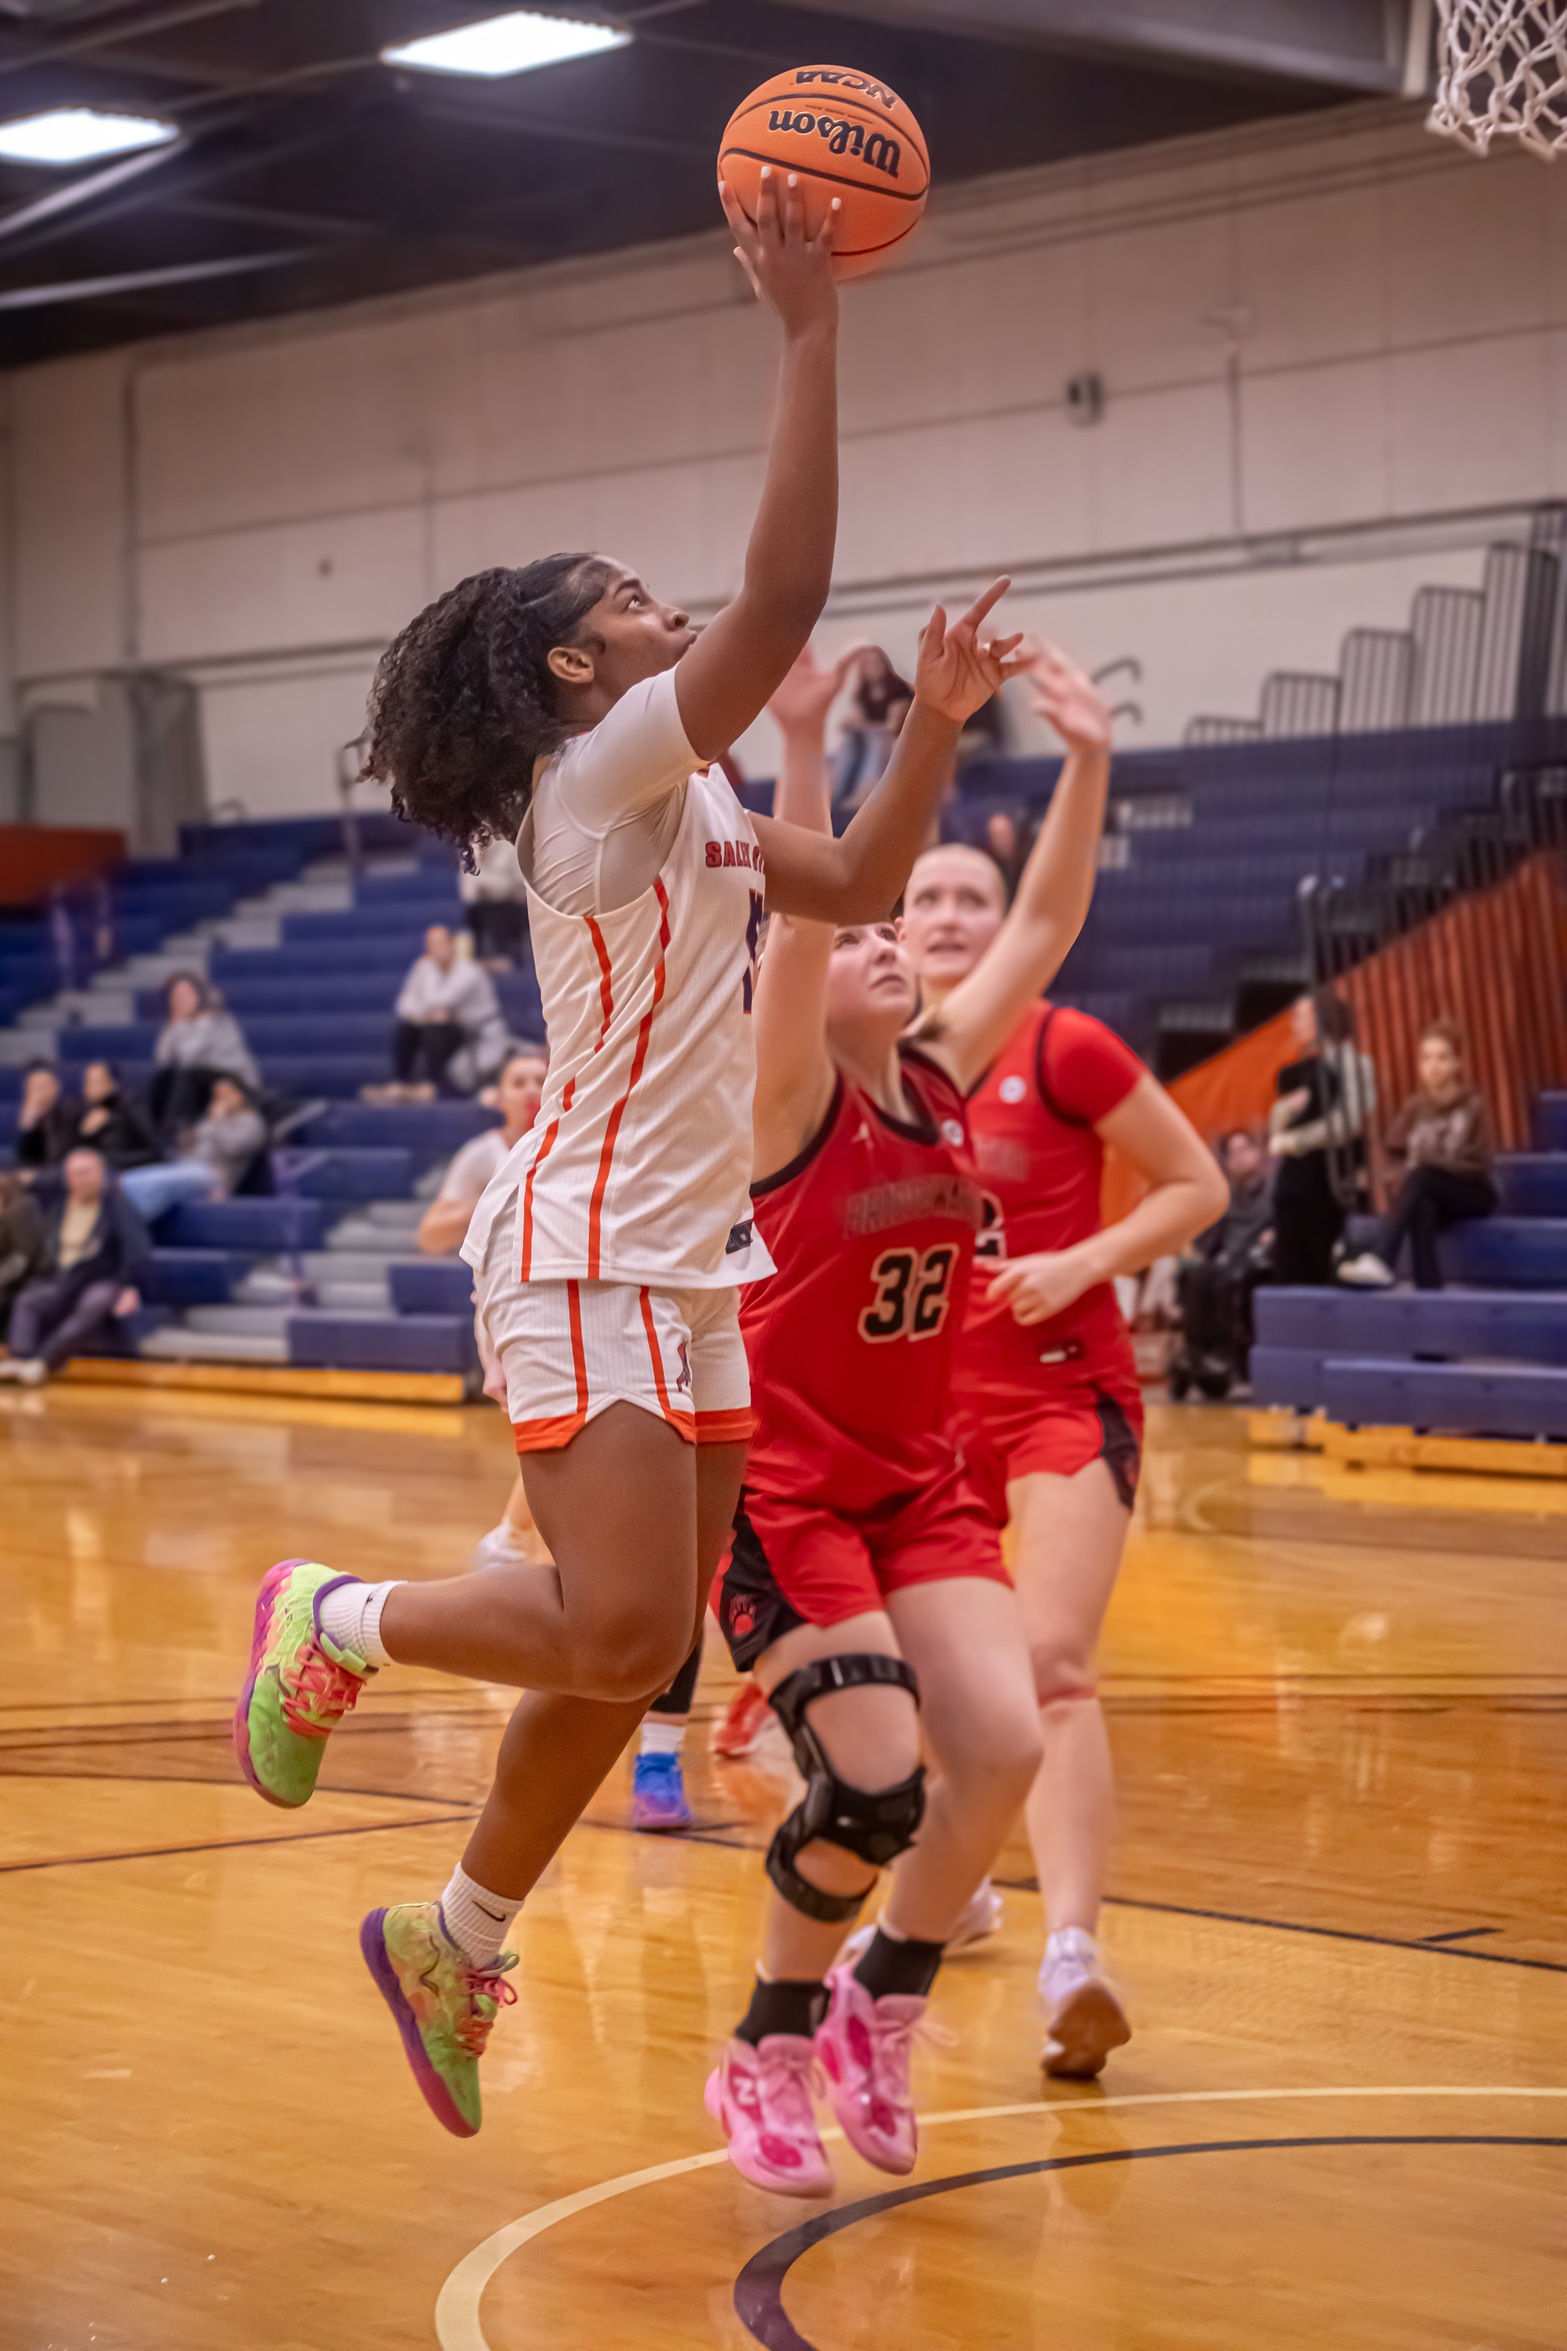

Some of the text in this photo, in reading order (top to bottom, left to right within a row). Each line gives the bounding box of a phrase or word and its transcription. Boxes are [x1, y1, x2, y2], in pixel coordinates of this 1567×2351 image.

[795, 70, 898, 111] NCAA
[768, 109, 901, 179] Wilson
[857, 1243, 960, 1344] 32
